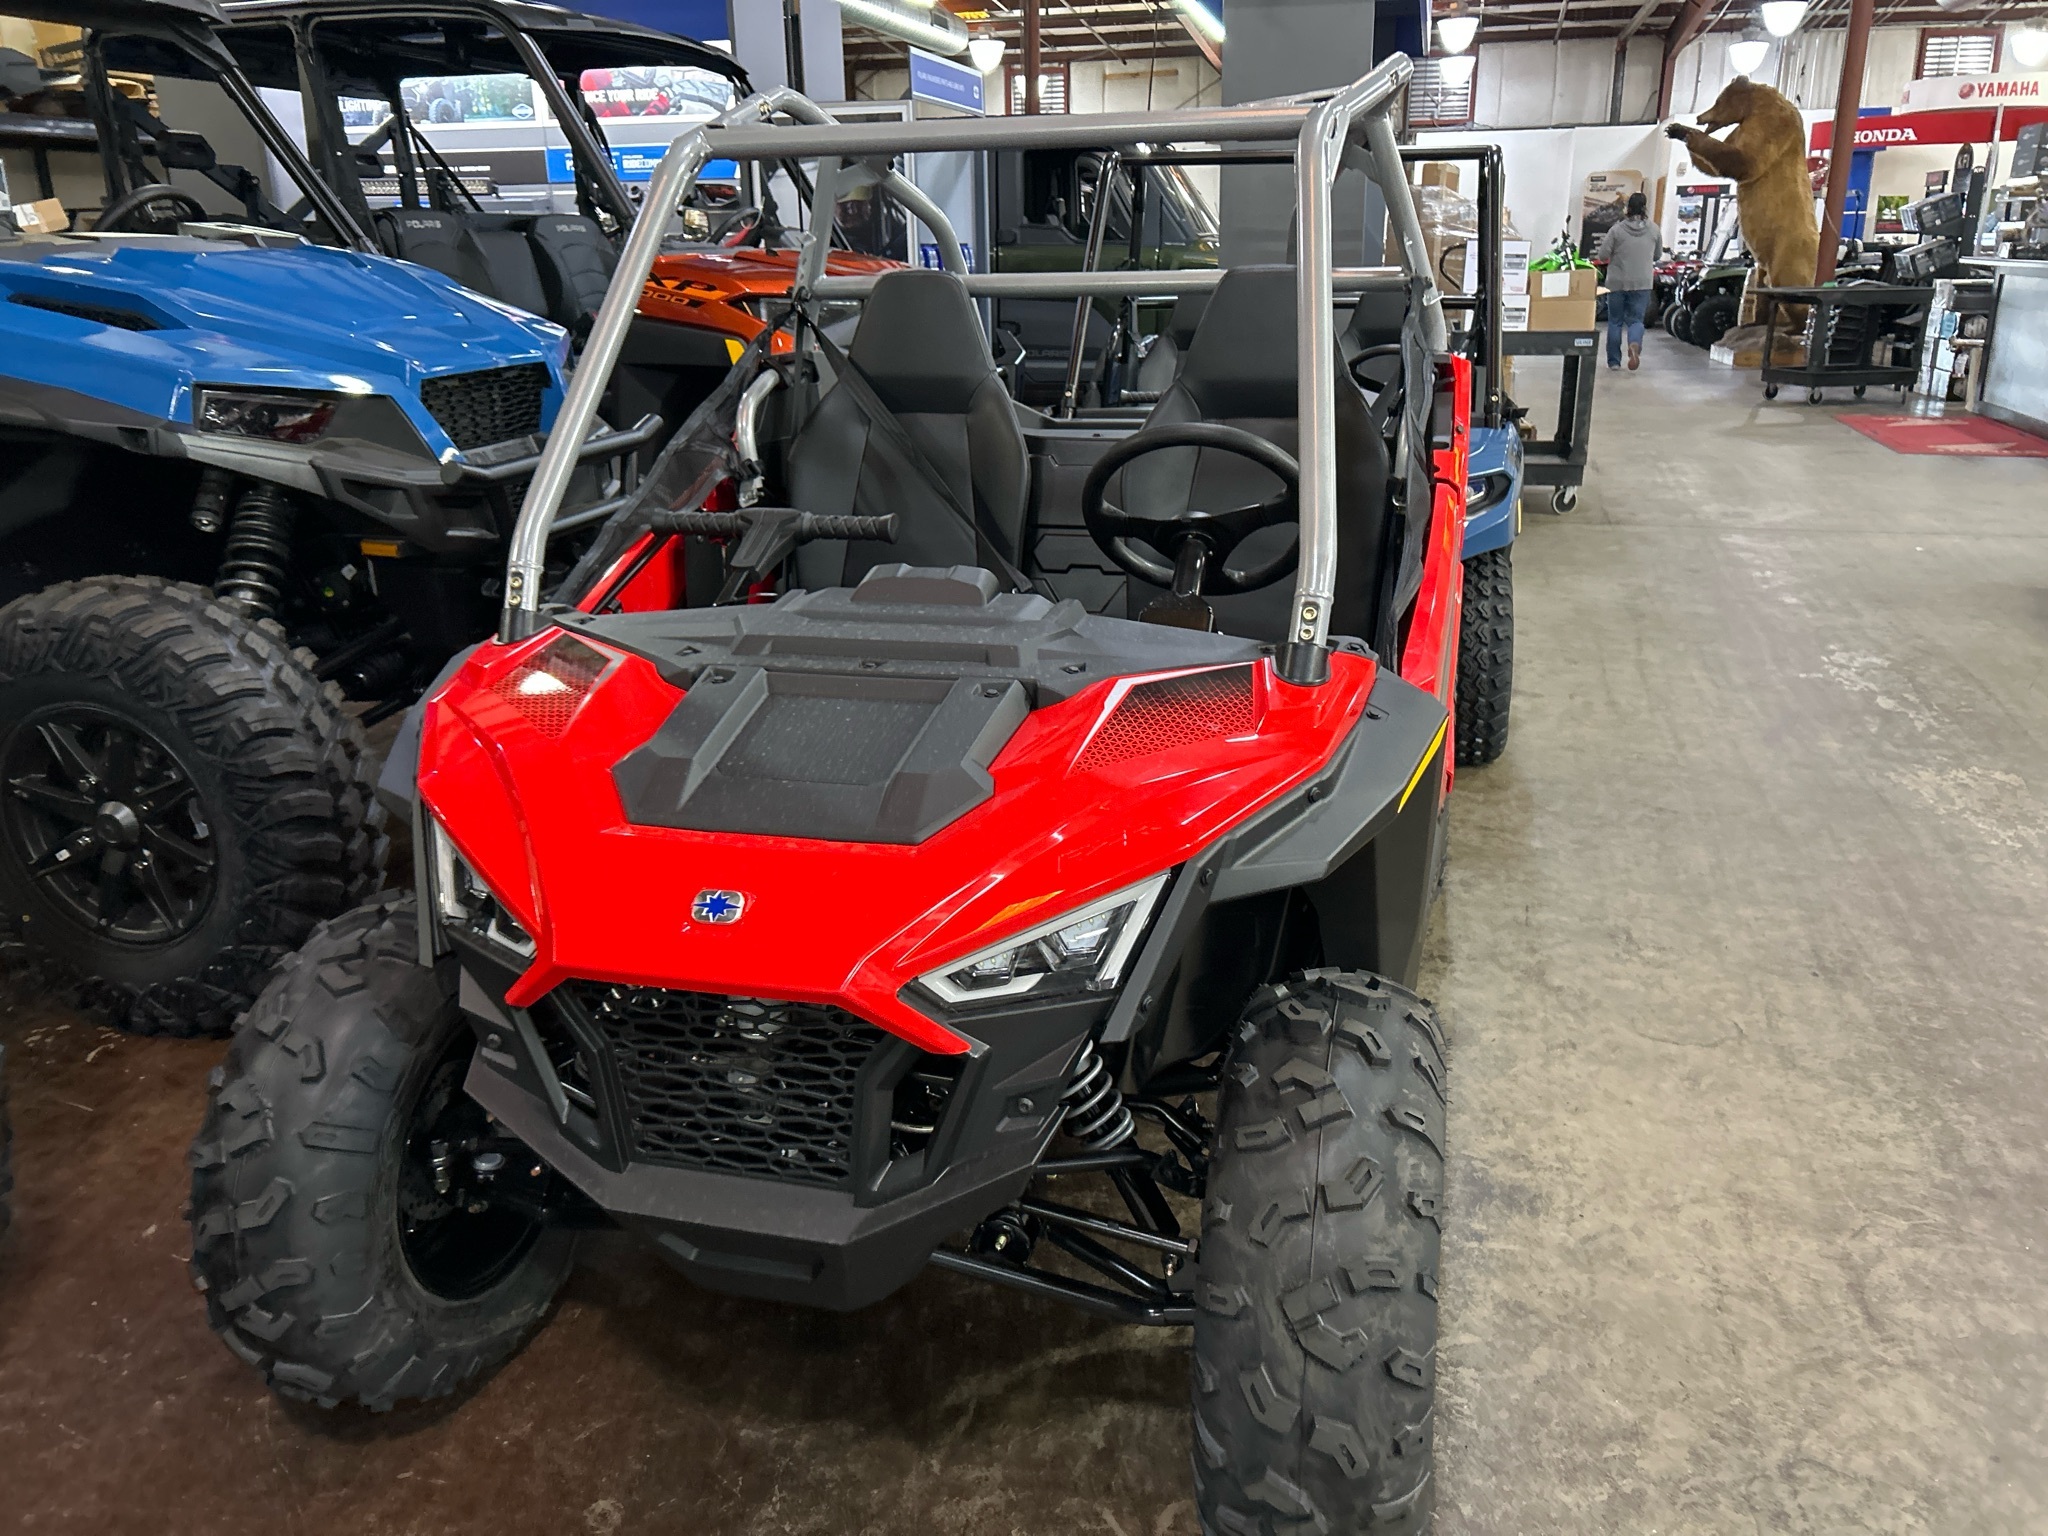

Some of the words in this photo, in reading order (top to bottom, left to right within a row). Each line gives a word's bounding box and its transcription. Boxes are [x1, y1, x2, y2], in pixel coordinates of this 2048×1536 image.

[1977, 81, 2039, 97] YAMAHA
[405, 219, 442, 229] POLARIS
[554, 224, 588, 233] POLARIS
